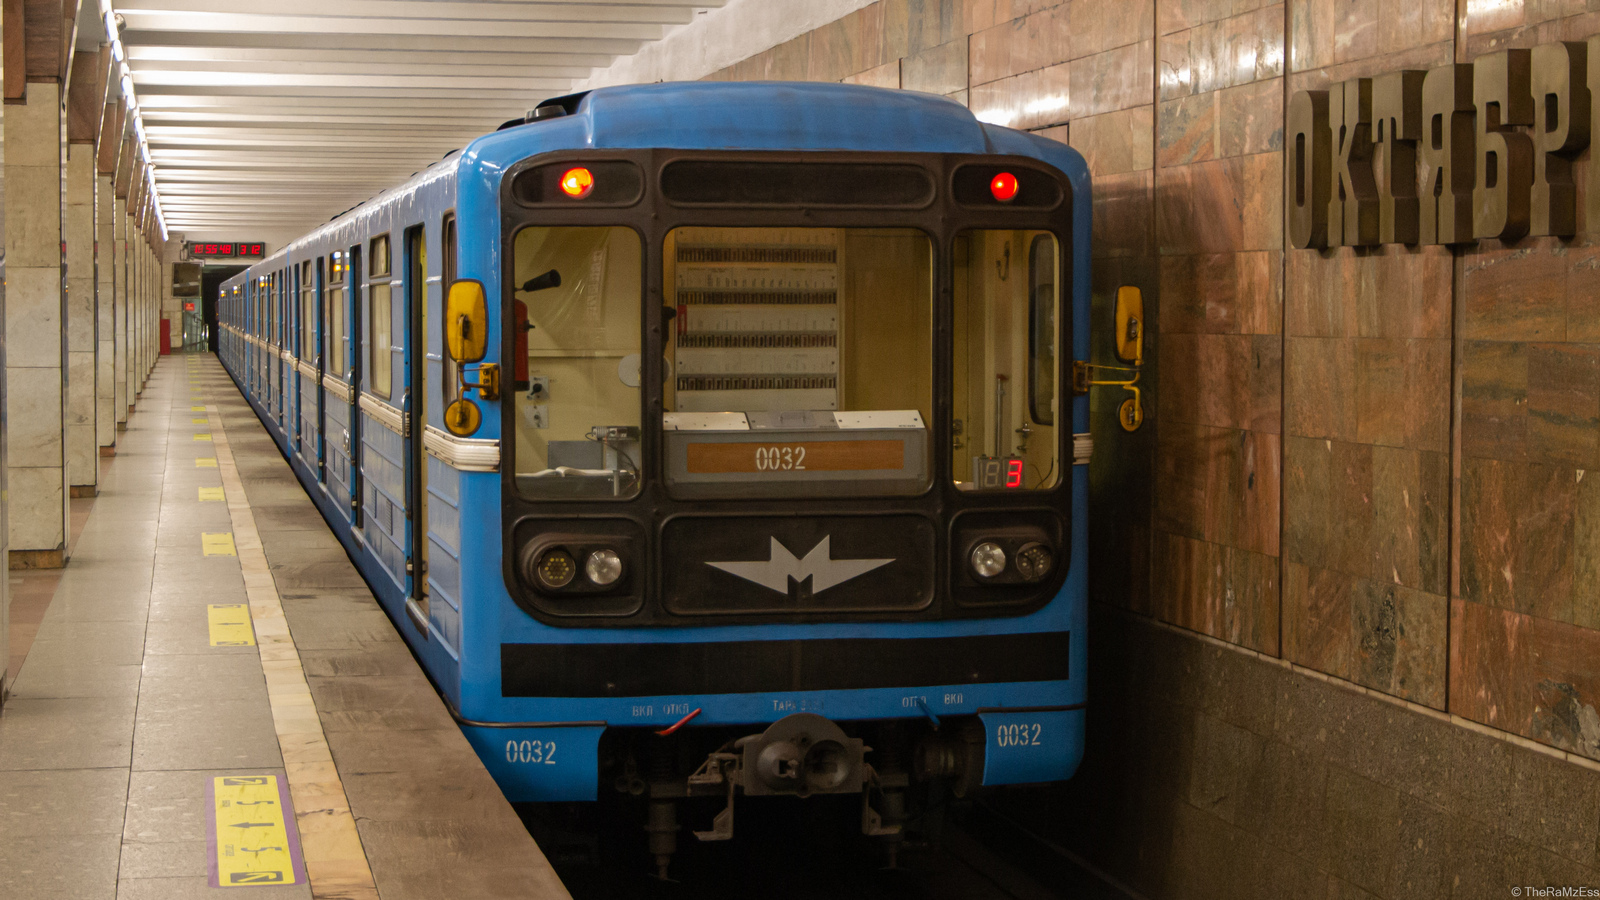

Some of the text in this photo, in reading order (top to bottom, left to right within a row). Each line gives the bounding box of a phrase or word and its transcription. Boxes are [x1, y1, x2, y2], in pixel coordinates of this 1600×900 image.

[1289, 37, 1600, 249] ОКТЯБР
[205, 244, 218, 254] 55
[219, 244, 231, 254] 48
[240, 245, 261, 255] 3 12
[755, 446, 807, 471] 0032
[944, 693, 963, 705] ВКЛ
[632, 703, 690, 717] ВКЛ ОТКЛ
[996, 723, 1042, 747] 0032
[505, 740, 557, 765] 0032
